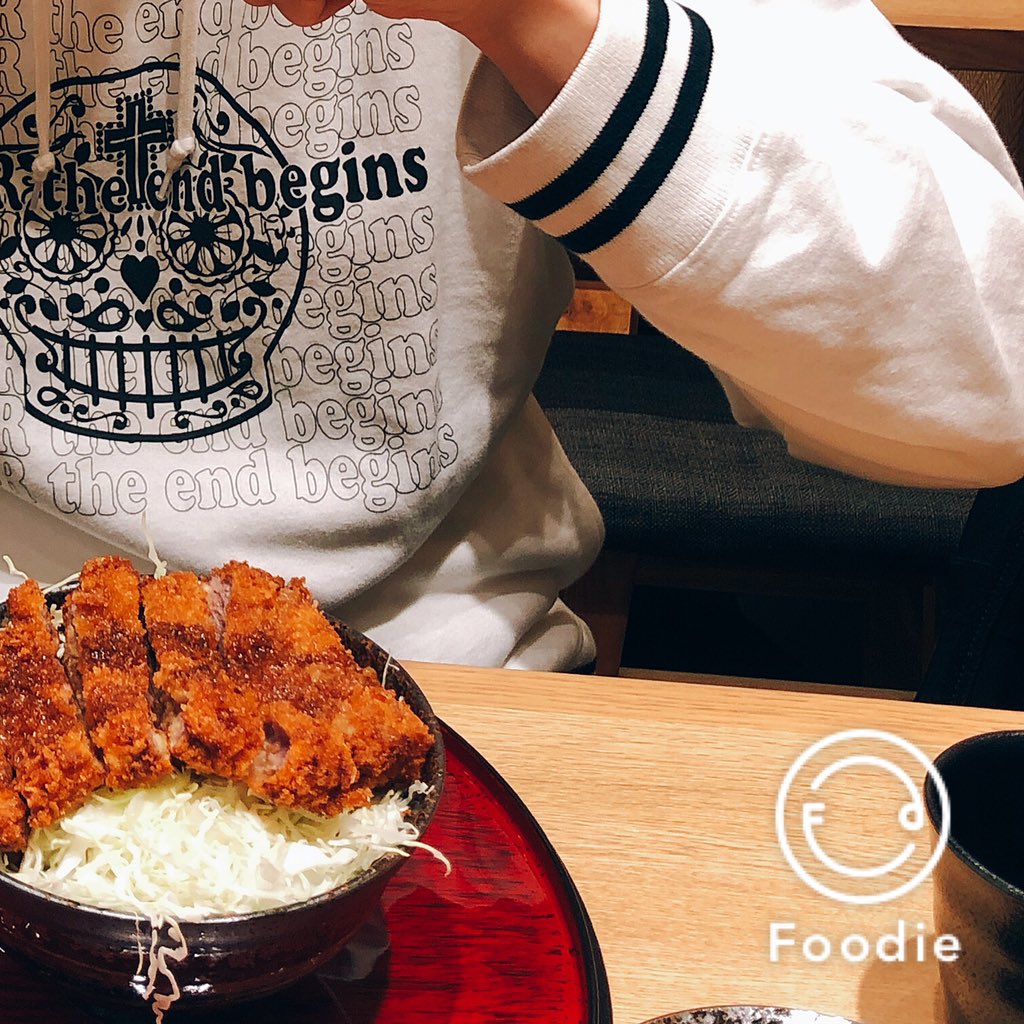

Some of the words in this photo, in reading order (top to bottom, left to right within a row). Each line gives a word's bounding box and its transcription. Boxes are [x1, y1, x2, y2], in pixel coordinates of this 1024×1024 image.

[237, 22, 416, 98] begins
[240, 146, 429, 222] begins
[47, 456, 148, 516] the
[164, 448, 276, 512] end
[286, 423, 459, 513] begins
